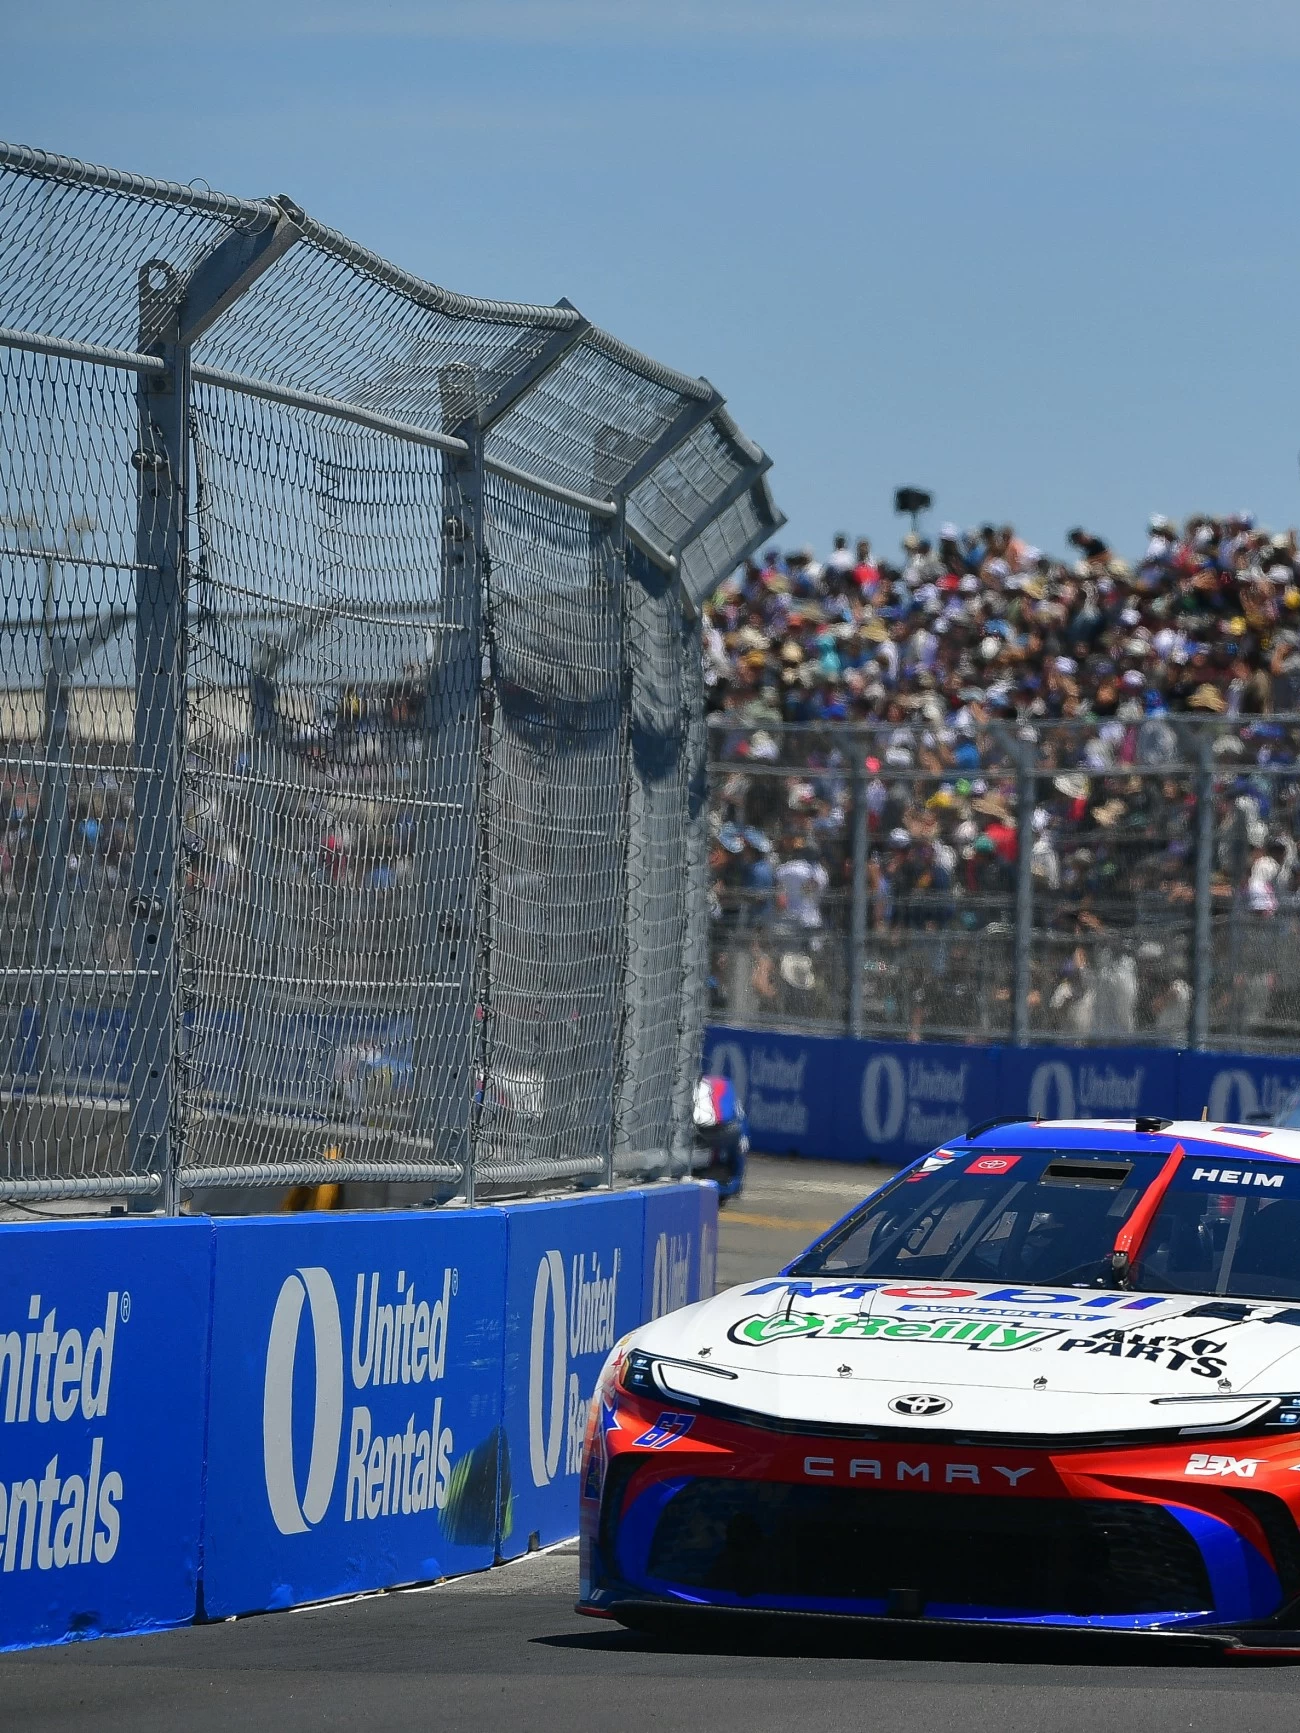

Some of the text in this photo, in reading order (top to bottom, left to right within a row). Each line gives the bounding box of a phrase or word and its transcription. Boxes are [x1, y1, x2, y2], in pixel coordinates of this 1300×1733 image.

[1191, 1168, 1285, 1188] HEIM
[743, 1281, 1173, 1310] Mobil
[911, 1305, 1096, 1321] AVAILABLE AT
[736, 1311, 1045, 1350] O'Reilly
[1057, 1338, 1228, 1379] PARTS
[632, 1412, 696, 1450] 67
[344, 1397, 453, 1522] Rentals
[804, 1457, 1036, 1486] CAMRY
[1184, 1453, 1269, 1478] 23XI
